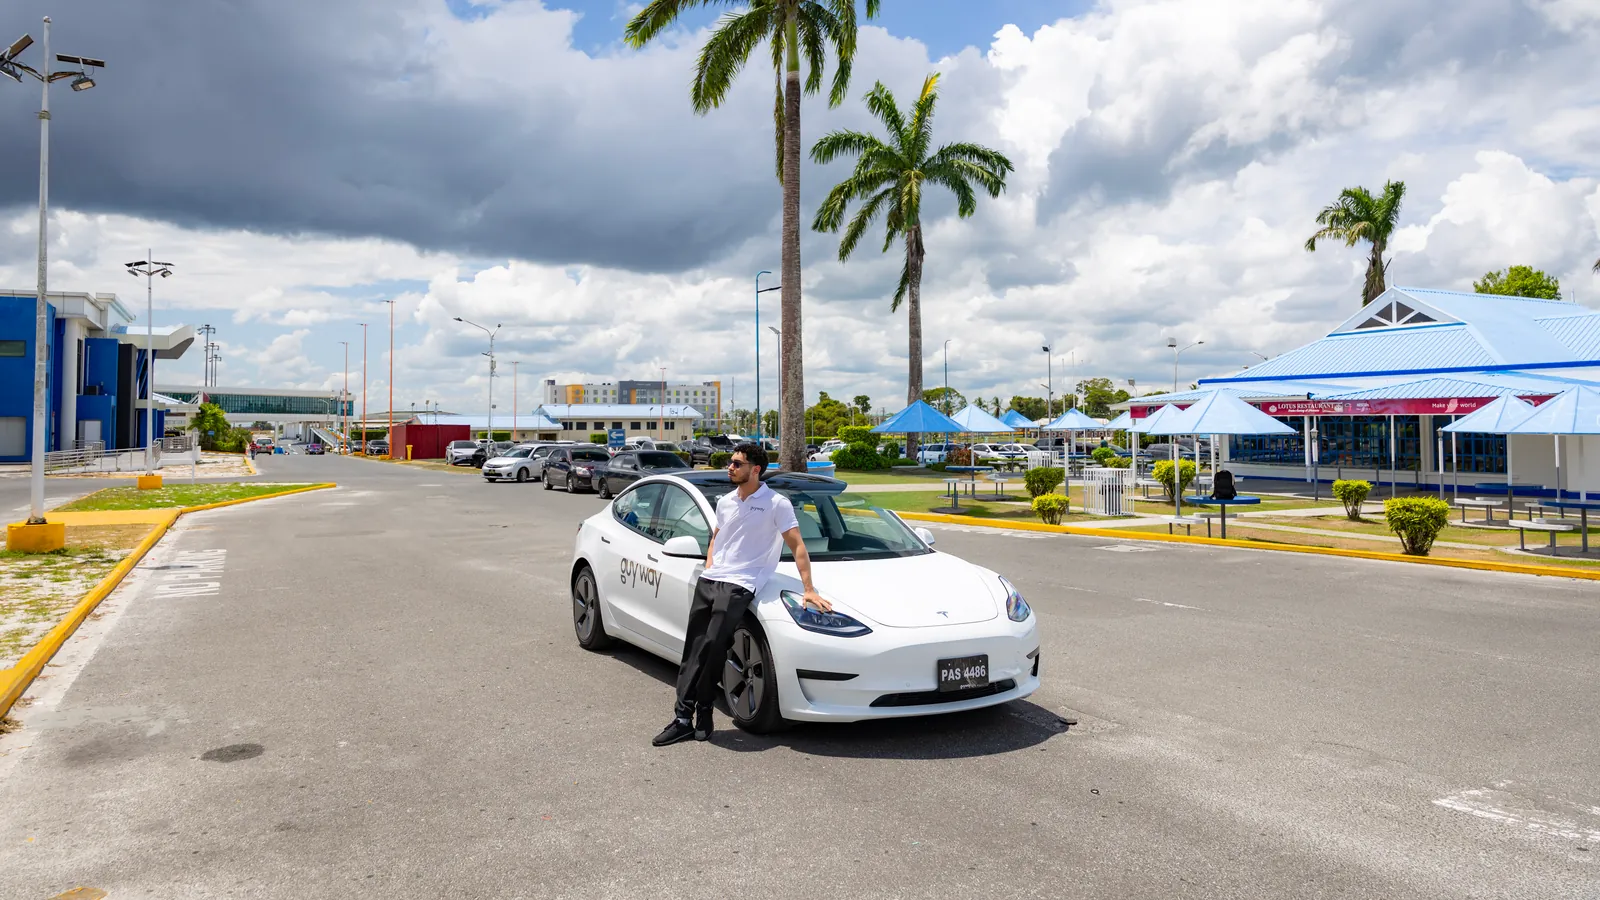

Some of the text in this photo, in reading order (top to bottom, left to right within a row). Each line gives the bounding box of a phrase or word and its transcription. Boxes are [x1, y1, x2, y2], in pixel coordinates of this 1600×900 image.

[151, 582, 220, 600] NO
[942, 665, 986, 681] PAS 4486
